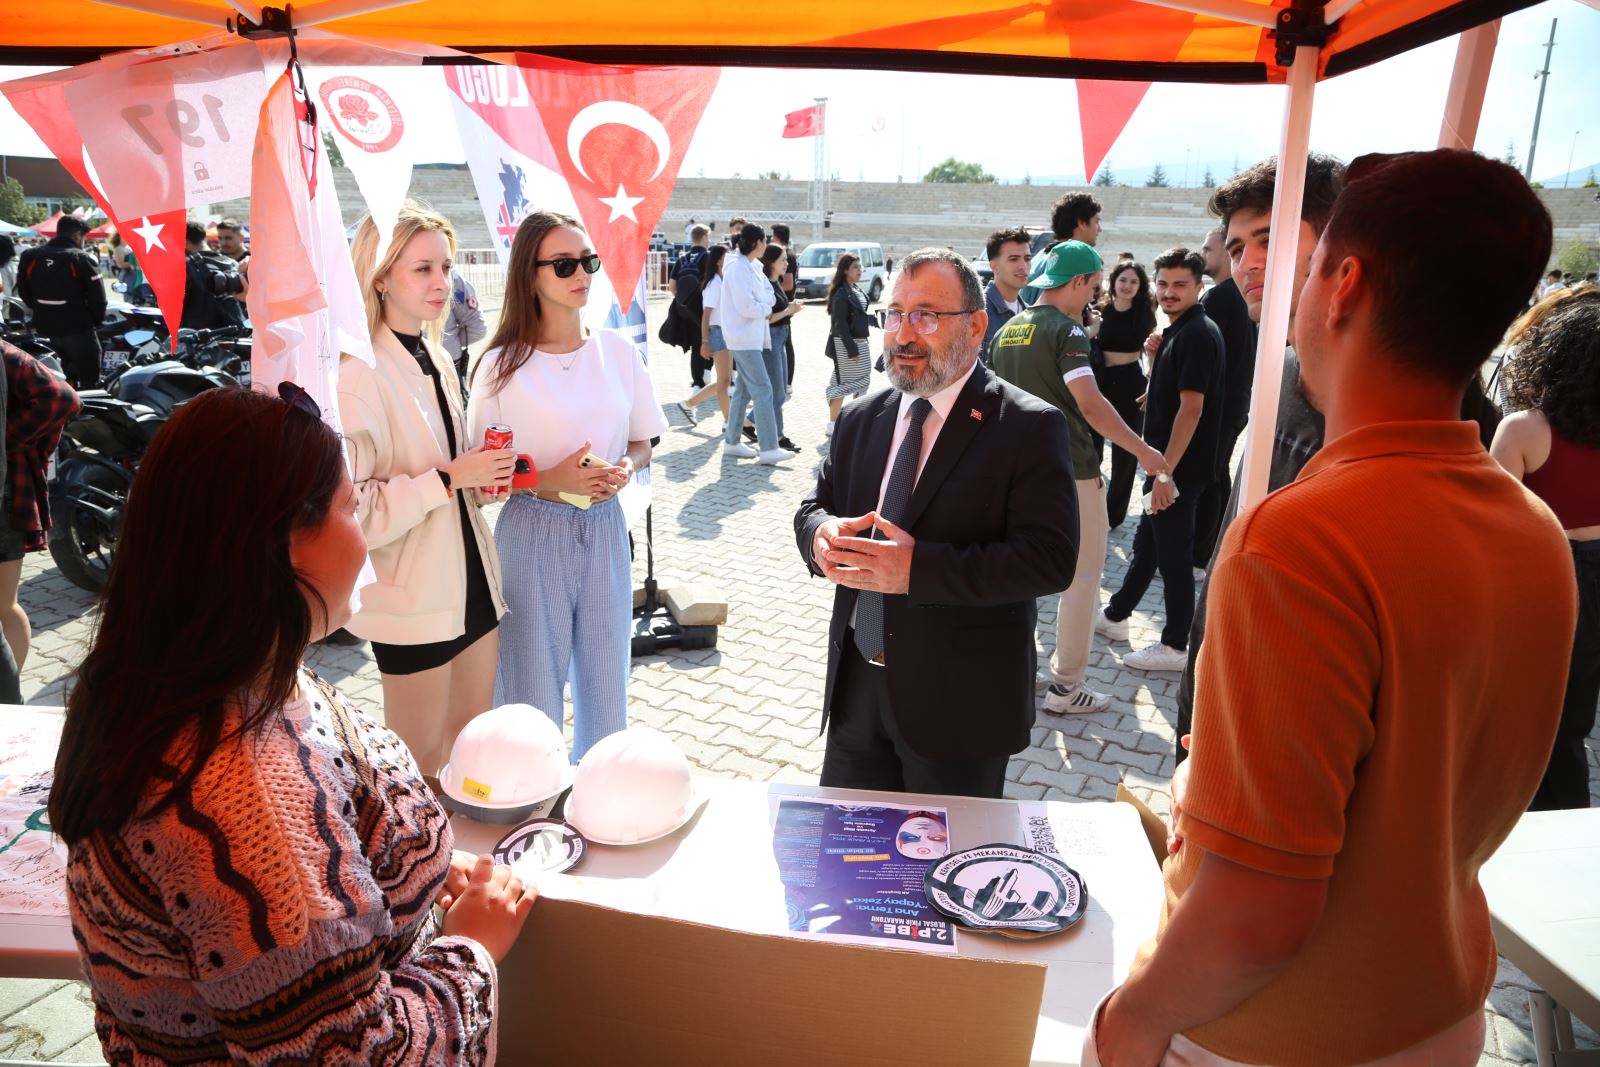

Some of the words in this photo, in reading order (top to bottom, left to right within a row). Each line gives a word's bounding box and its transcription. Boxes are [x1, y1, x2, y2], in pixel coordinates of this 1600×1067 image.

[940, 859, 961, 876] KENTSEL
[855, 905, 893, 914] Tema:
[895, 907, 919, 917] Ana
[871, 915, 904, 926] MARATONU
[905, 918, 921, 927] FİKİR
[921, 919, 945, 928] ULUSAL
